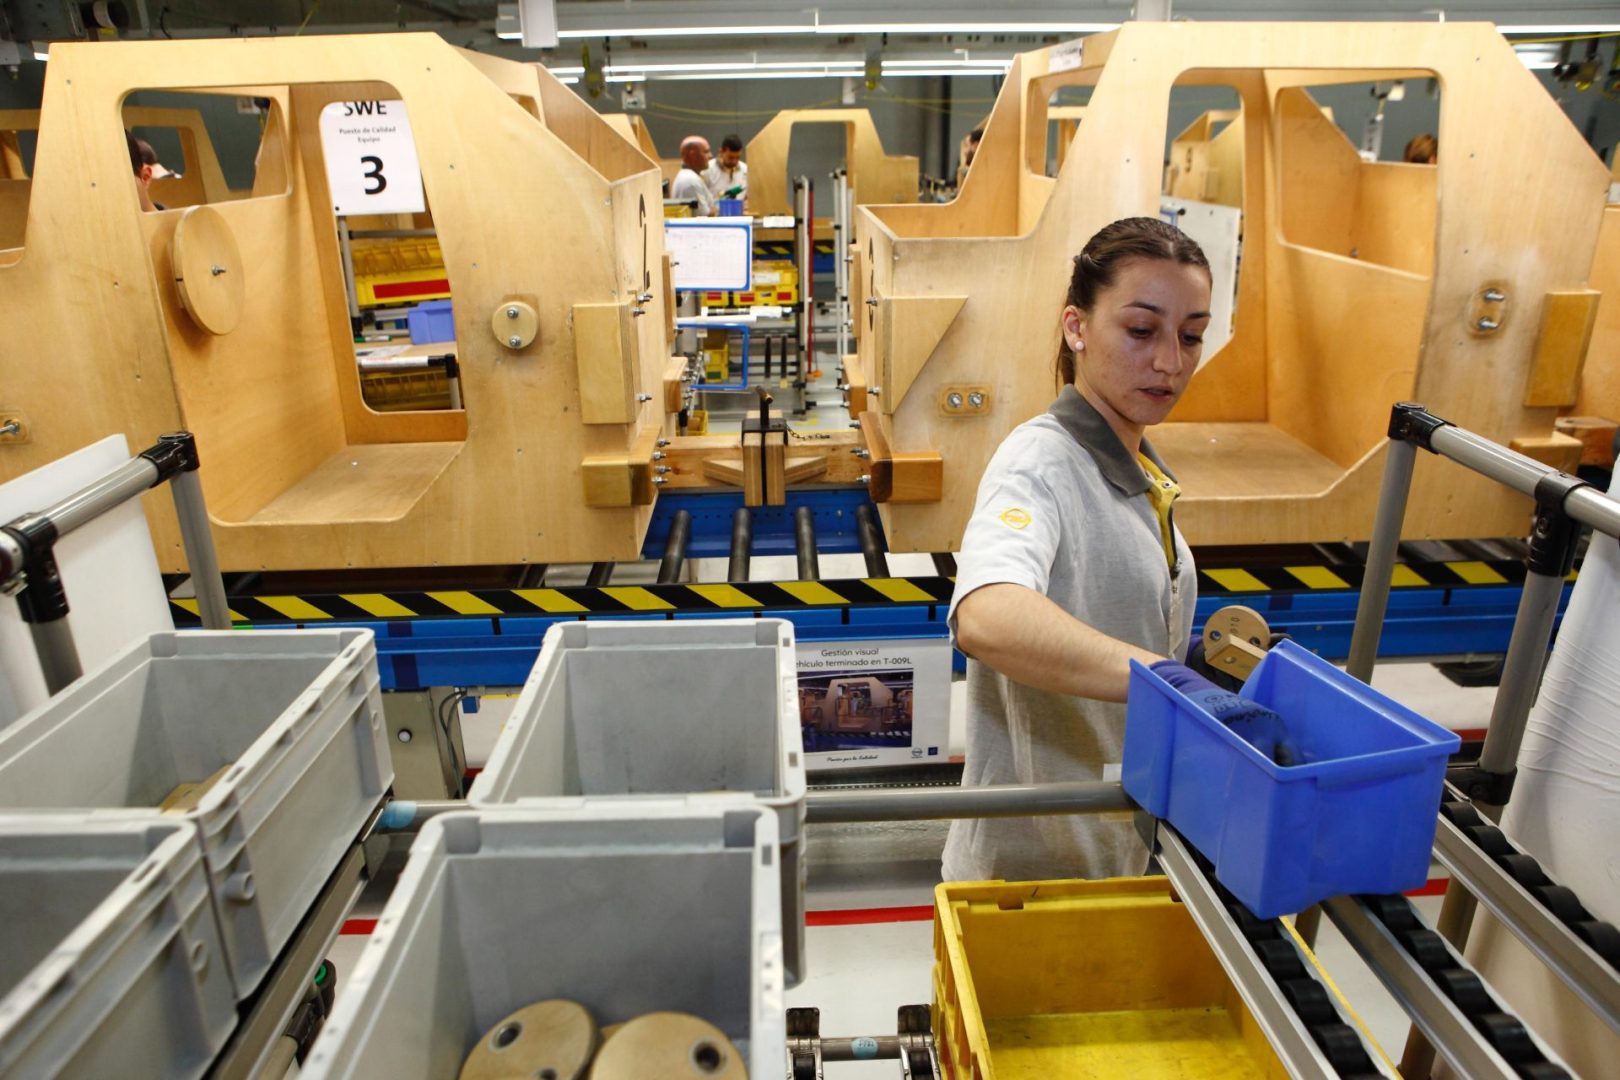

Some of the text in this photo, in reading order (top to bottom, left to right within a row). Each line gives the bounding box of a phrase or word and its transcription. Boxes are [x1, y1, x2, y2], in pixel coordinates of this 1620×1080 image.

[343, 100, 387, 116] SWE
[339, 127, 361, 135] Puesto
[371, 125, 396, 133] Calidad
[357, 136, 381, 144] Equipo
[360, 155, 387, 195] 3
[821, 647, 880, 657] Gestión visual
[825, 658, 869, 667] terminado
[870, 658, 881, 666] en
